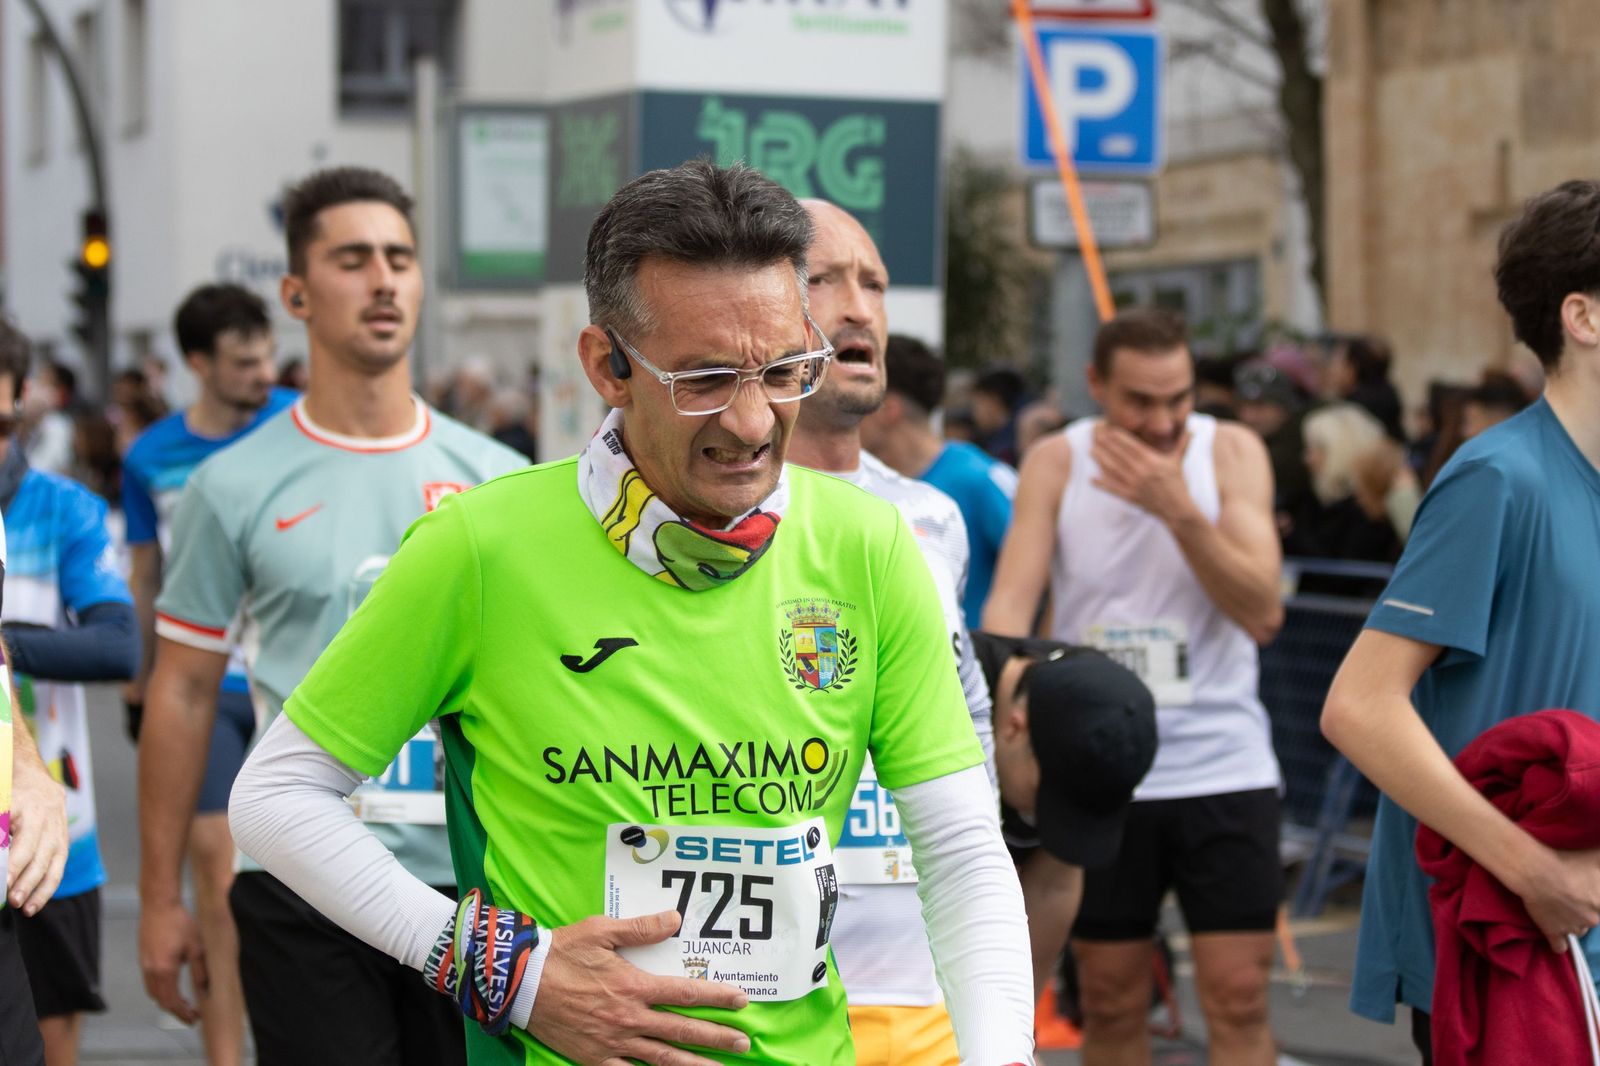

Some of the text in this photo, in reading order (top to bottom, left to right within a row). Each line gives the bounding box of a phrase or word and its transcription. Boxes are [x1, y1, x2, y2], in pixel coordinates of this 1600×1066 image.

[1046, 38, 1138, 155] P
[831, 599, 857, 611] PARATUS
[542, 737, 829, 784] SANMAXIMO
[643, 779, 812, 818] TELECOM
[675, 835, 815, 866] SETEL
[662, 869, 774, 941] 725
[682, 941, 752, 955] JUANCAR
[713, 970, 779, 983] Ayuntamiento
